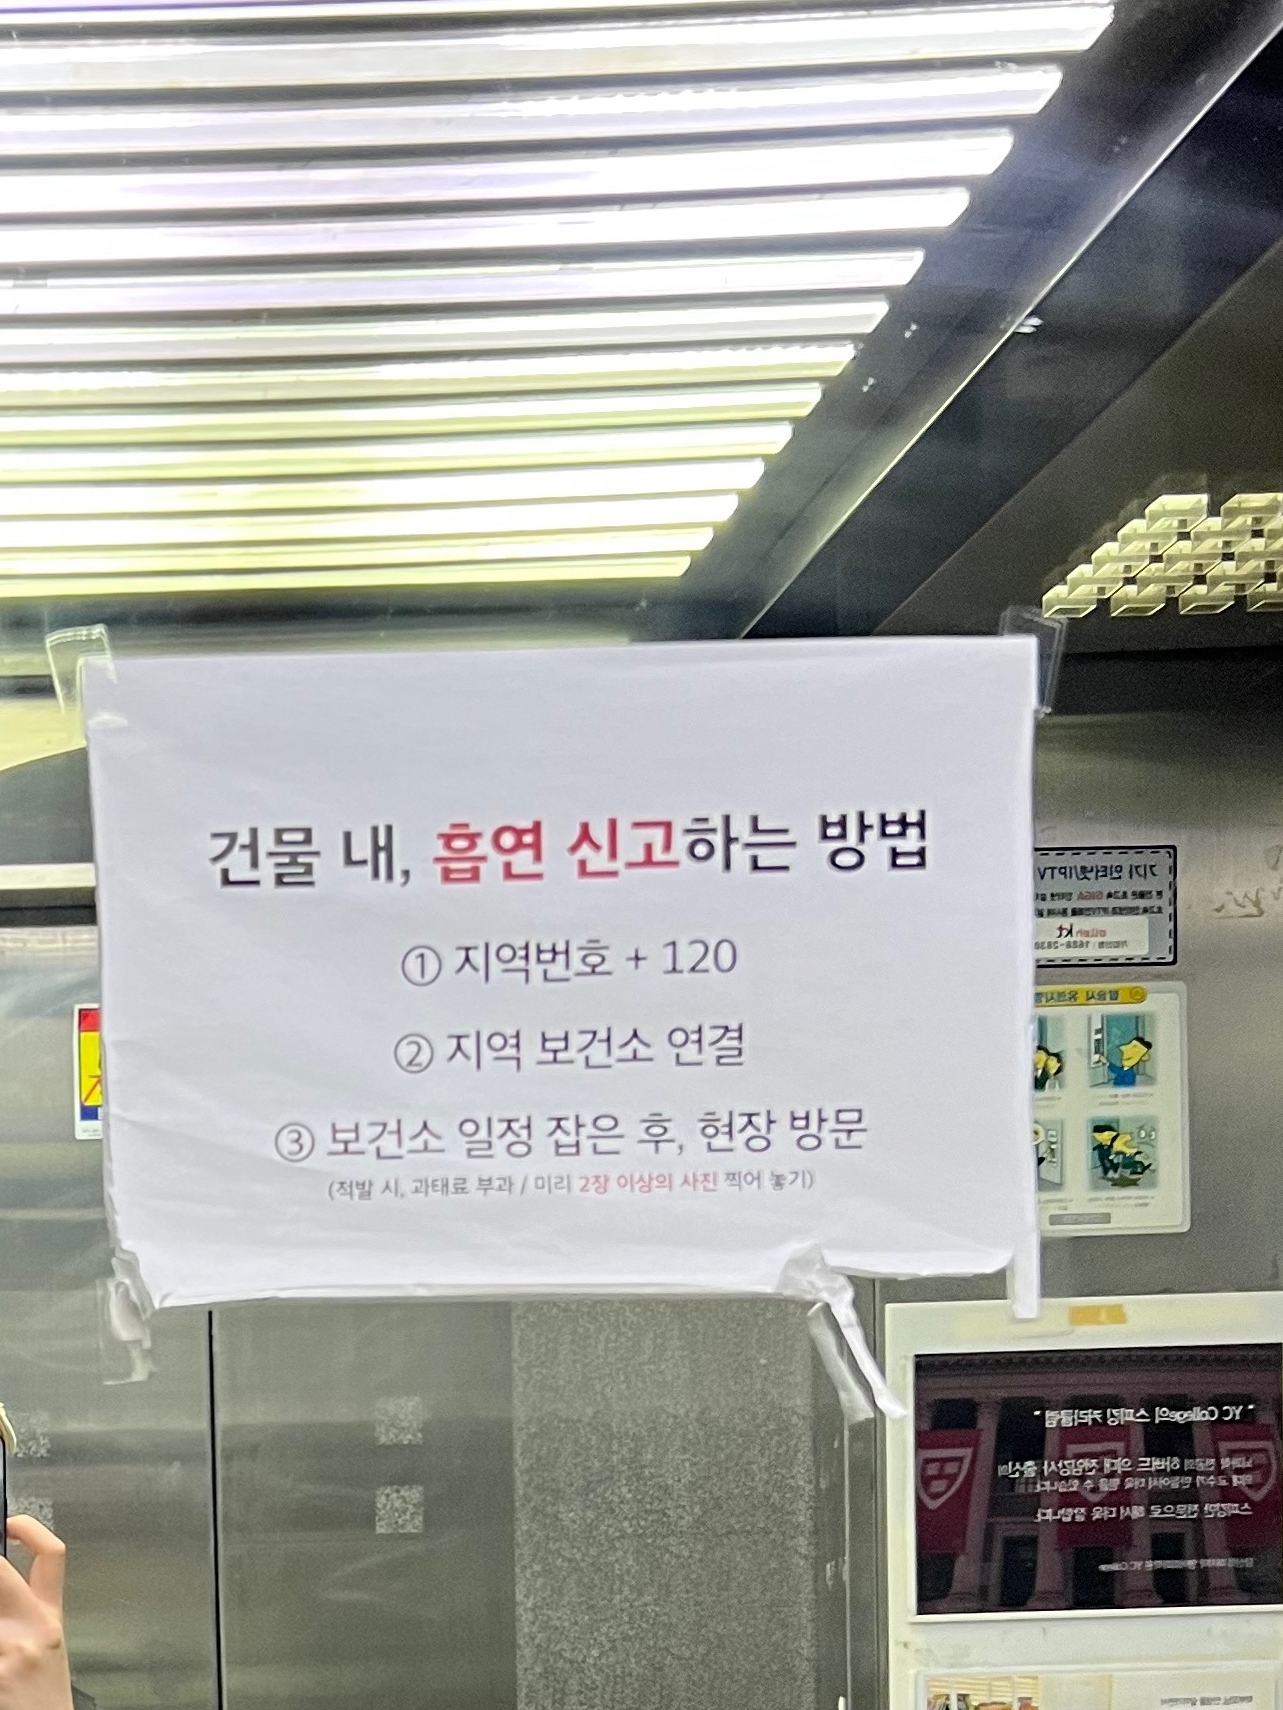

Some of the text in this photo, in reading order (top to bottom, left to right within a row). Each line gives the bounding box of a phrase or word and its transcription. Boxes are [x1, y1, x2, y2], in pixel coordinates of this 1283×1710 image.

[209, 809, 927, 888] 건물 내, 흡연 신고하는 방법
[455, 939, 613, 985] 지역번호
[625, 947, 648, 970] +
[663, 938, 738, 975] 120
[447, 1029, 521, 1073] 지역
[536, 1026, 654, 1070] 보건소
[667, 1022, 744, 1067] 연결
[326, 1118, 446, 1161] 보건소
[458, 1115, 532, 1159] 일정
[546, 1113, 625, 1157] 잡은
[637, 1112, 684, 1156] 후,
[697, 1109, 778, 1153] 현장
[789, 1107, 868, 1152] 방문
[328, 1169, 814, 1201] (적발 시, 과태료 부과 / 미리 2장 이상의 사진 찍어 놓기)
